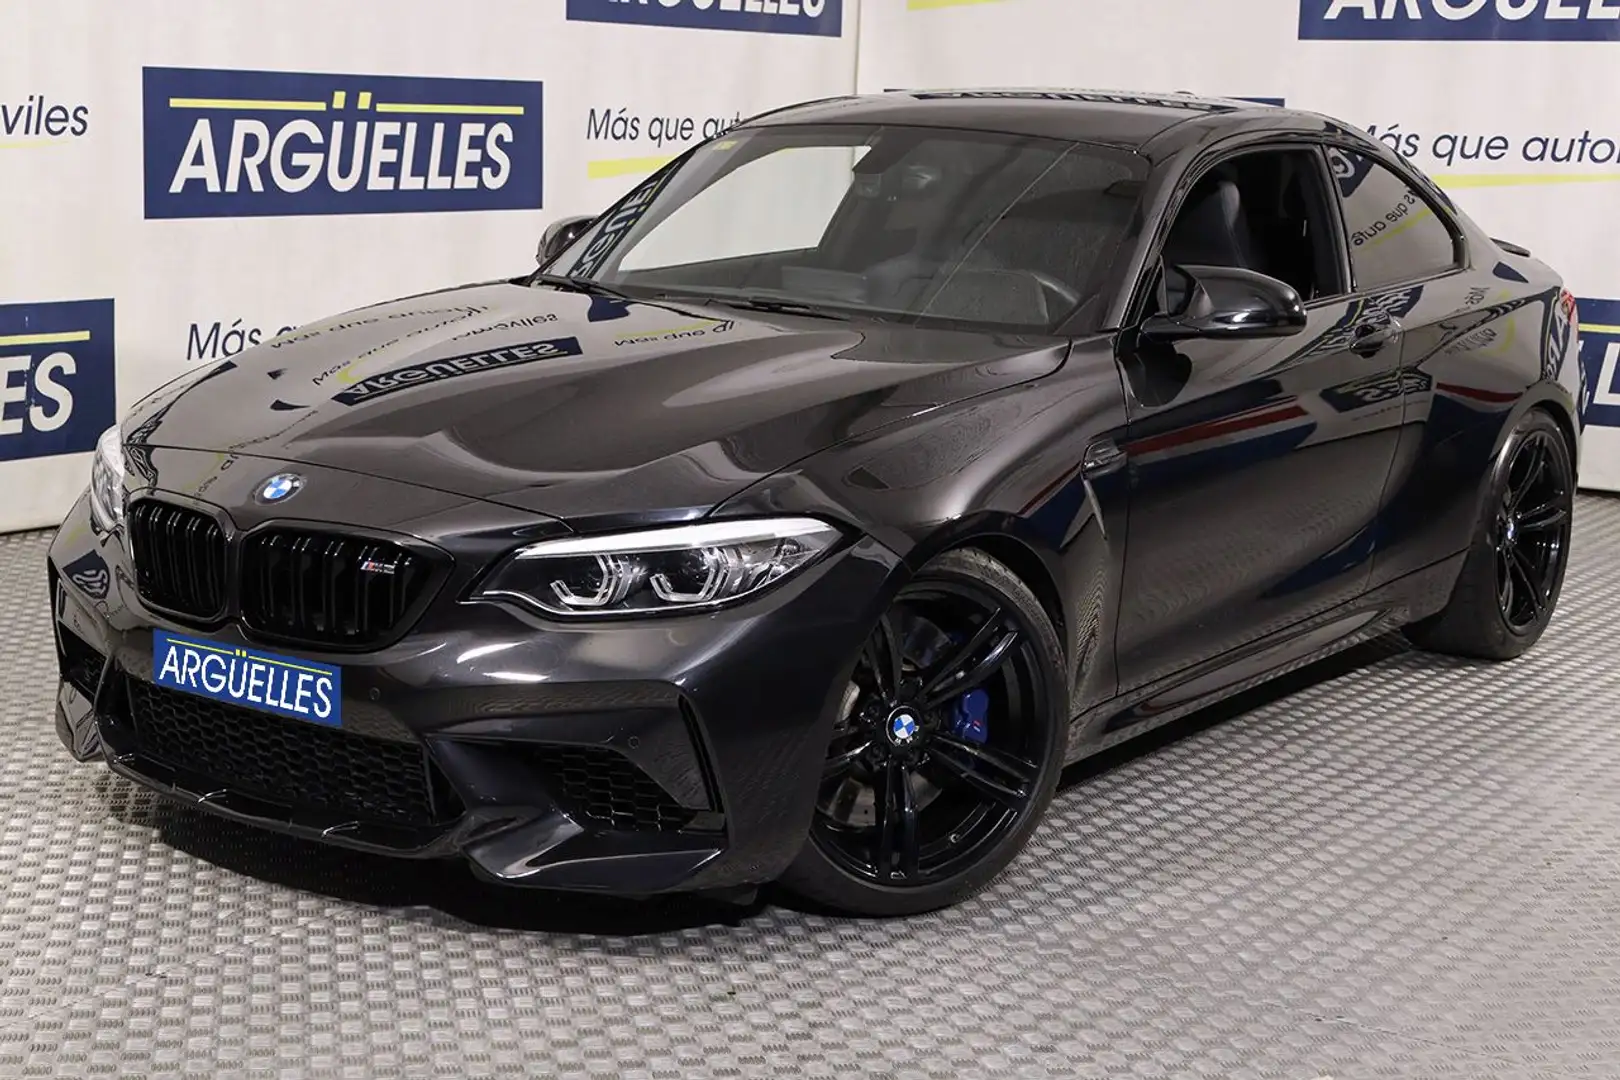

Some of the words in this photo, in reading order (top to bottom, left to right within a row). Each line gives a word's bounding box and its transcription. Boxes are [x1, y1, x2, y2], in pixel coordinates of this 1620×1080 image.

[168, 91, 514, 193] ARGÜELLES
[586, 107, 640, 140] Más
[647, 117, 694, 148] que
[1432, 132, 1509, 166] que
[159, 645, 333, 718] ARGÜELLES
